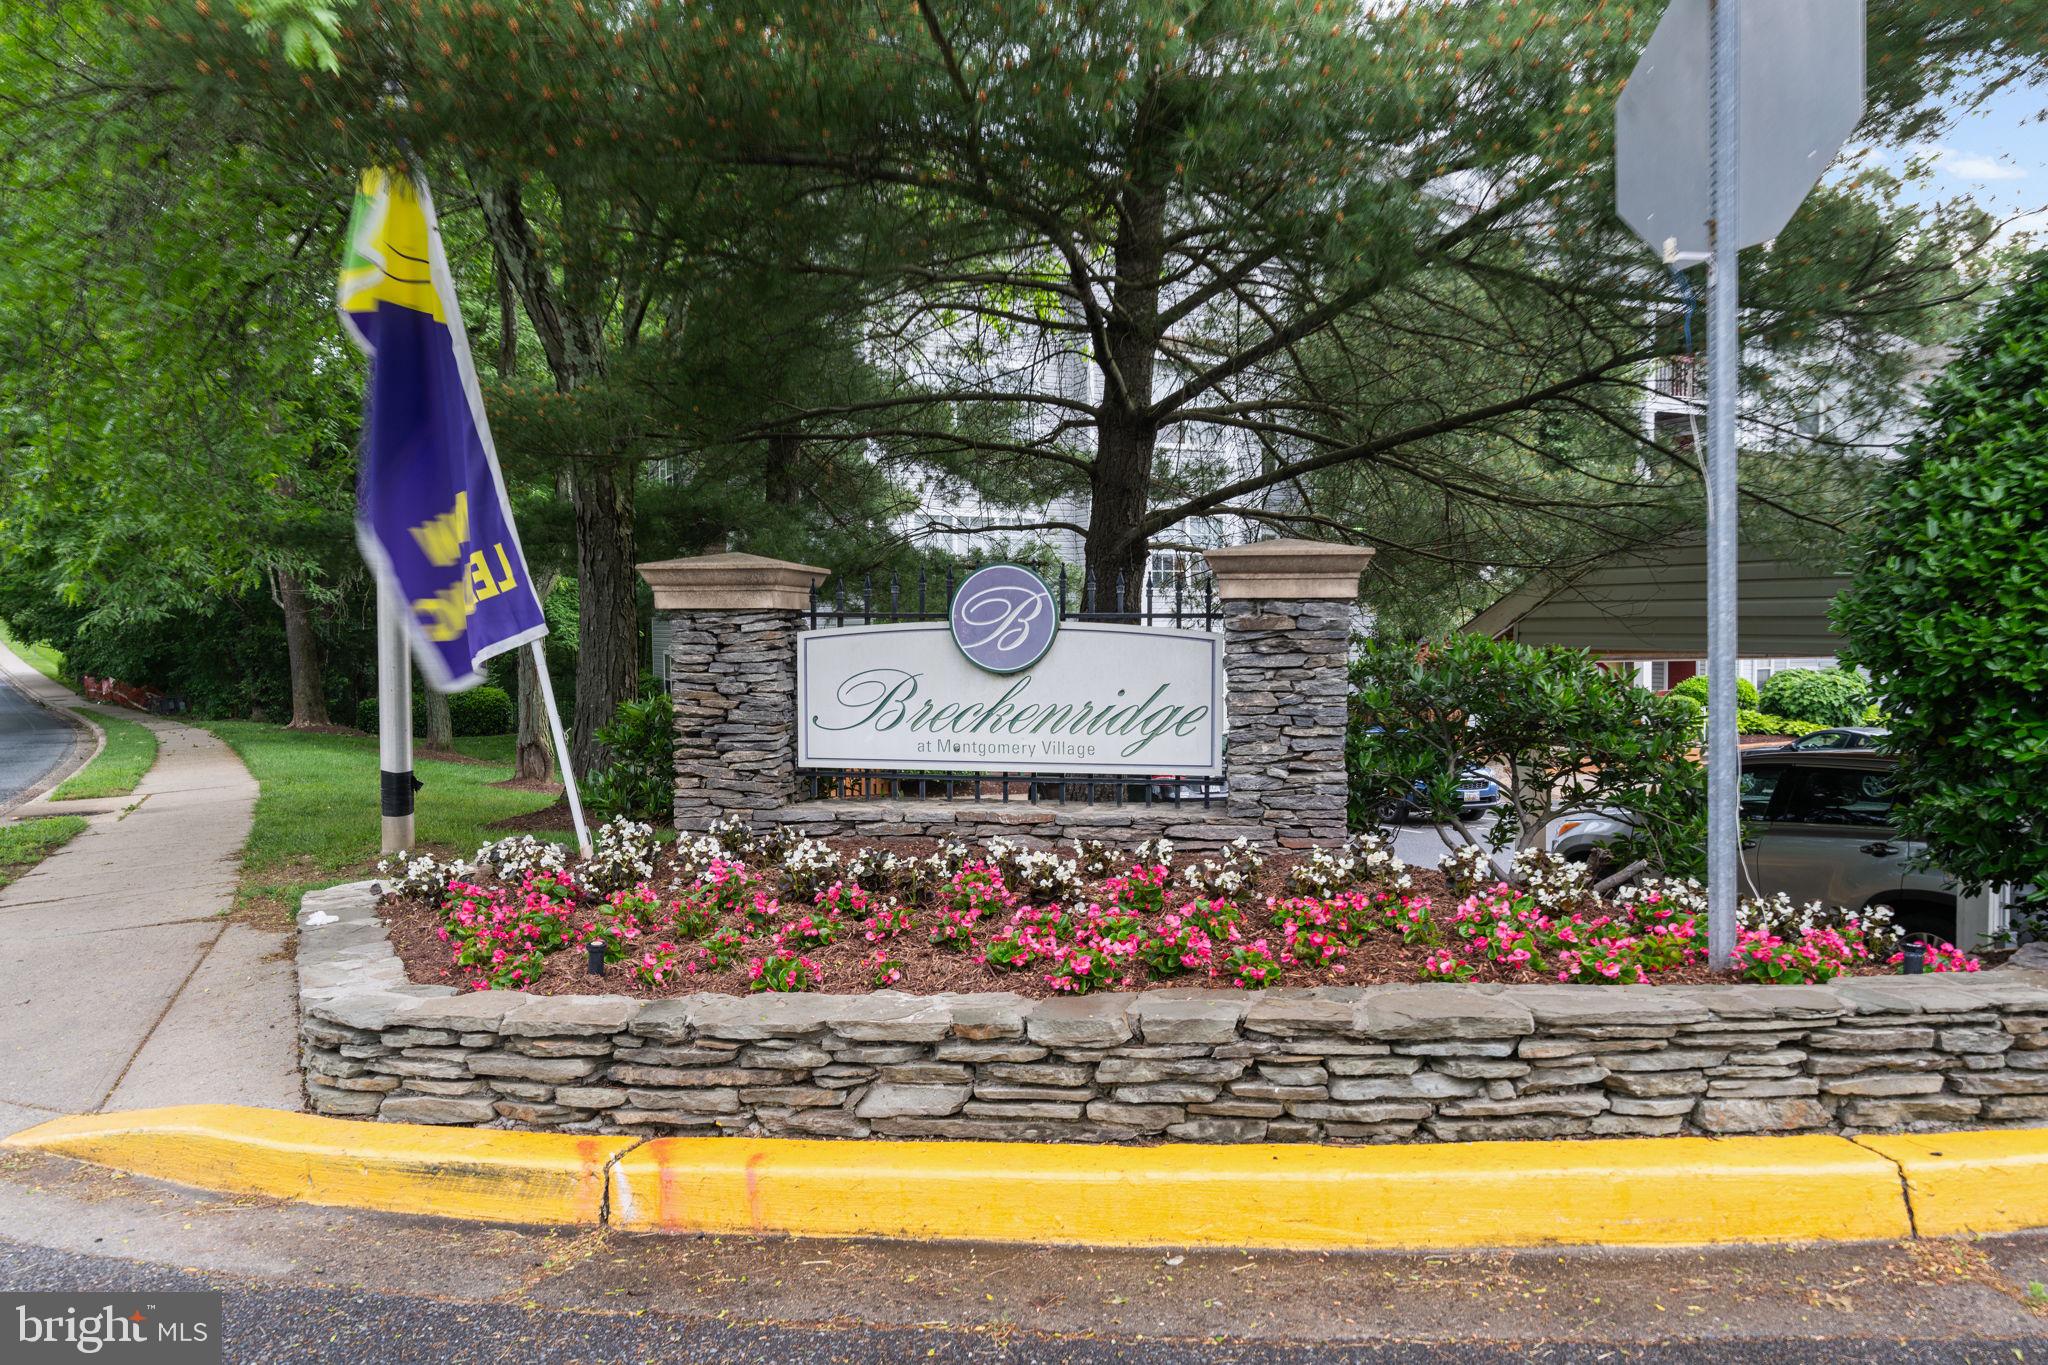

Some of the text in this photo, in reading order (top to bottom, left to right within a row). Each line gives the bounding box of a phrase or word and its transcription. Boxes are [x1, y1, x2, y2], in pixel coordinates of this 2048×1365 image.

[962, 586, 1050, 651] B
[812, 668, 1209, 758] Breckenridge
[917, 738, 1096, 759] at Montgomery Village
